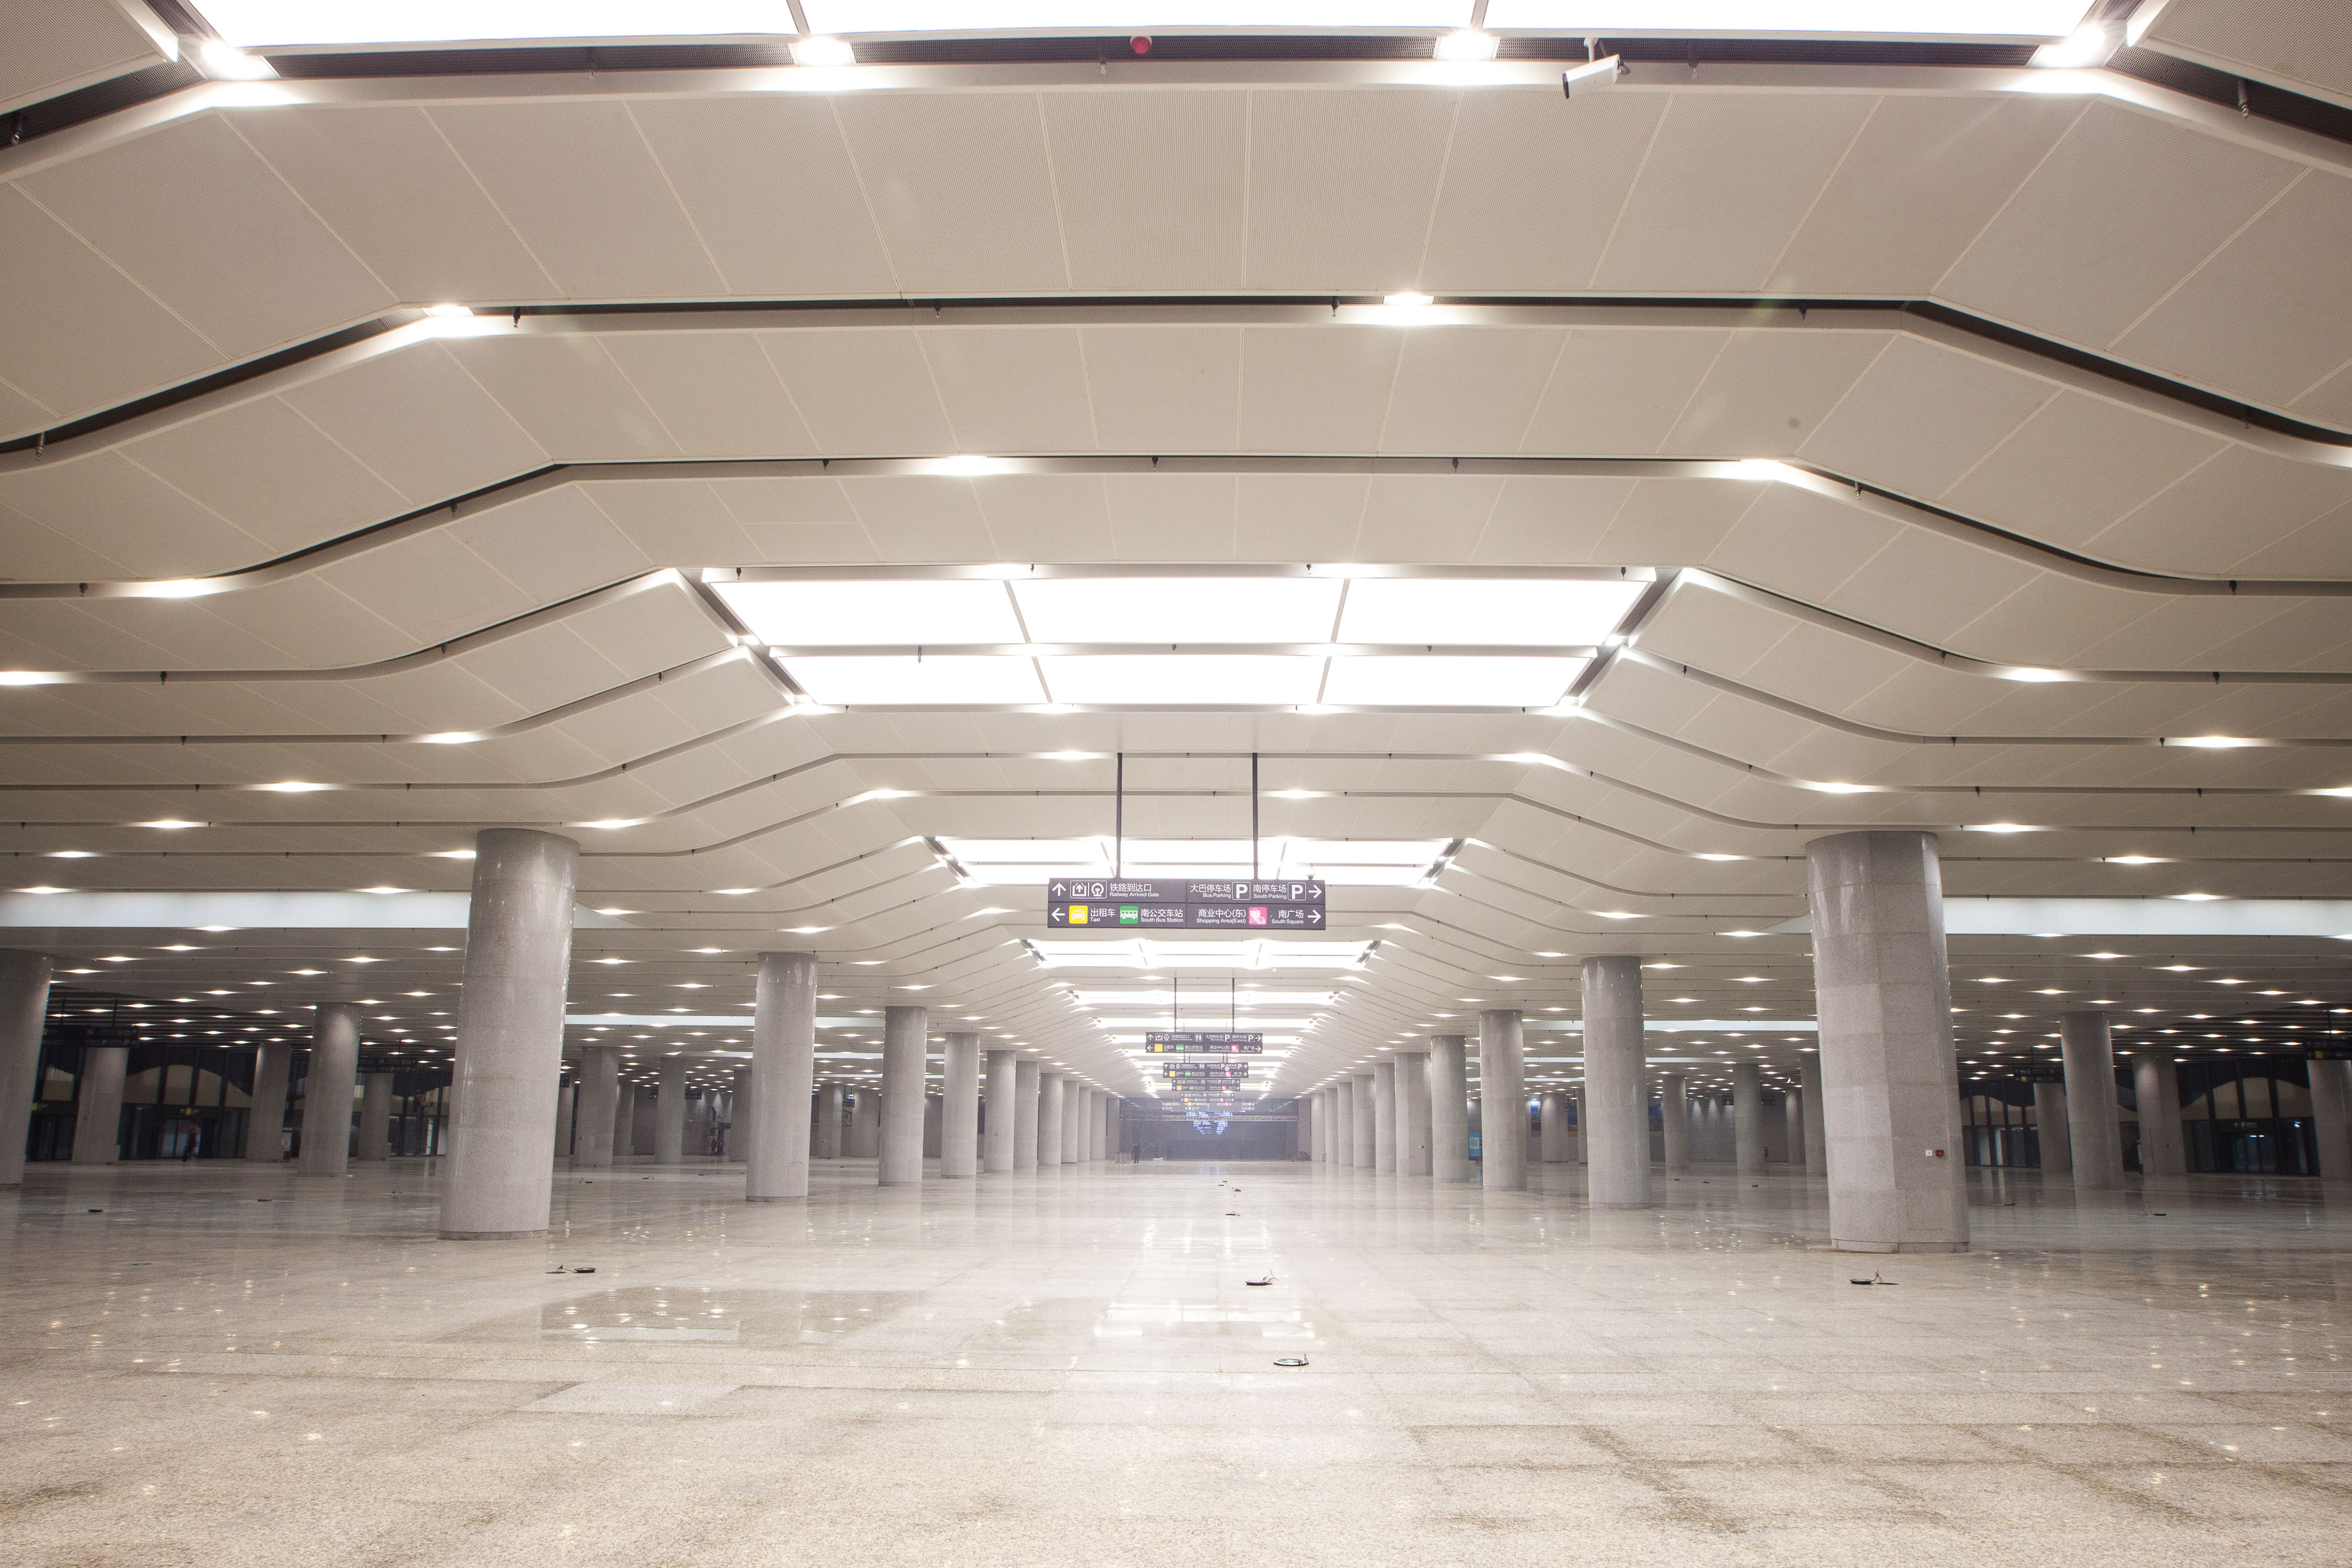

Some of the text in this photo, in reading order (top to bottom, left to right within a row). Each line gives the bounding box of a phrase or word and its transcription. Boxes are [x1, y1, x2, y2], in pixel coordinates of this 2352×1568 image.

[1110, 883, 1151, 892] 铁路到达口
[1190, 884, 1231, 893] 大巴停车场
[1236, 884, 1248, 899] P
[1253, 884, 1287, 893] 南停车场
[1291, 884, 1304, 900] P
[1090, 908, 1116, 917] 出租车
[1140, 908, 1183, 918] 南公交车站
[1278, 909, 1304, 919] 南广场
